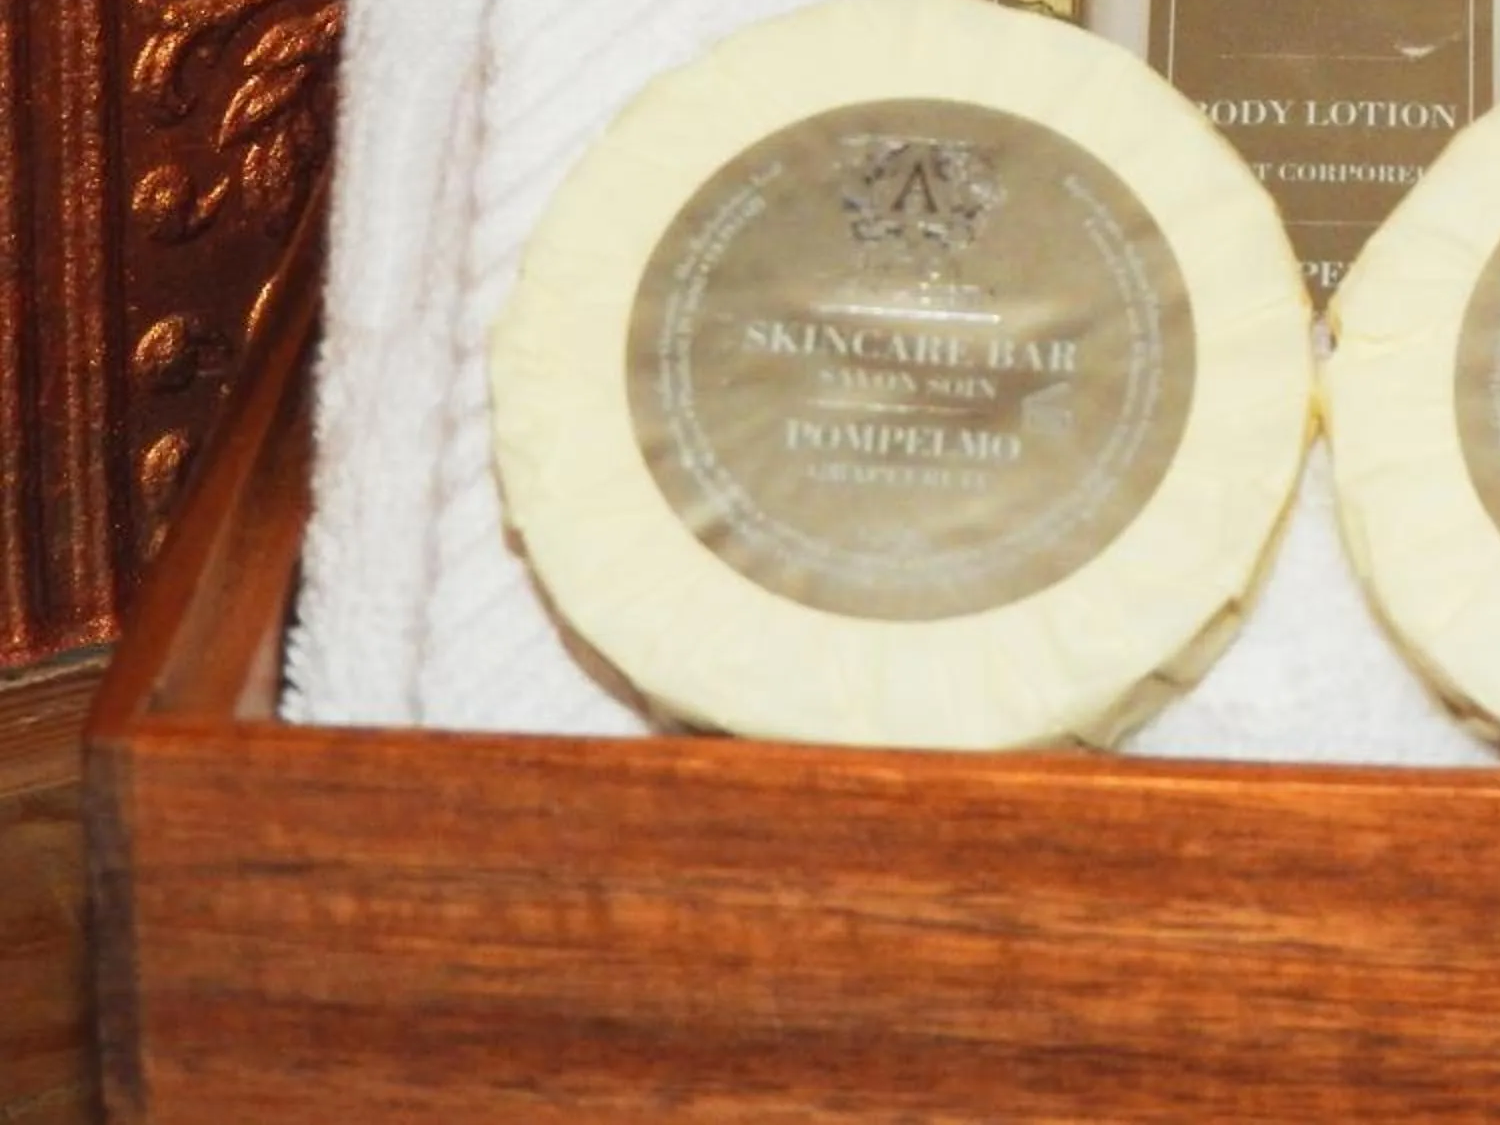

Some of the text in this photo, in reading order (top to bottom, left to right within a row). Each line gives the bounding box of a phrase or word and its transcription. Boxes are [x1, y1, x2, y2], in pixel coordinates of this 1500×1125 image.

[1305, 100, 1458, 129] LOTION
[741, 321, 1077, 373] SKINCARE BAR
[784, 419, 1022, 461] POMPELMO
